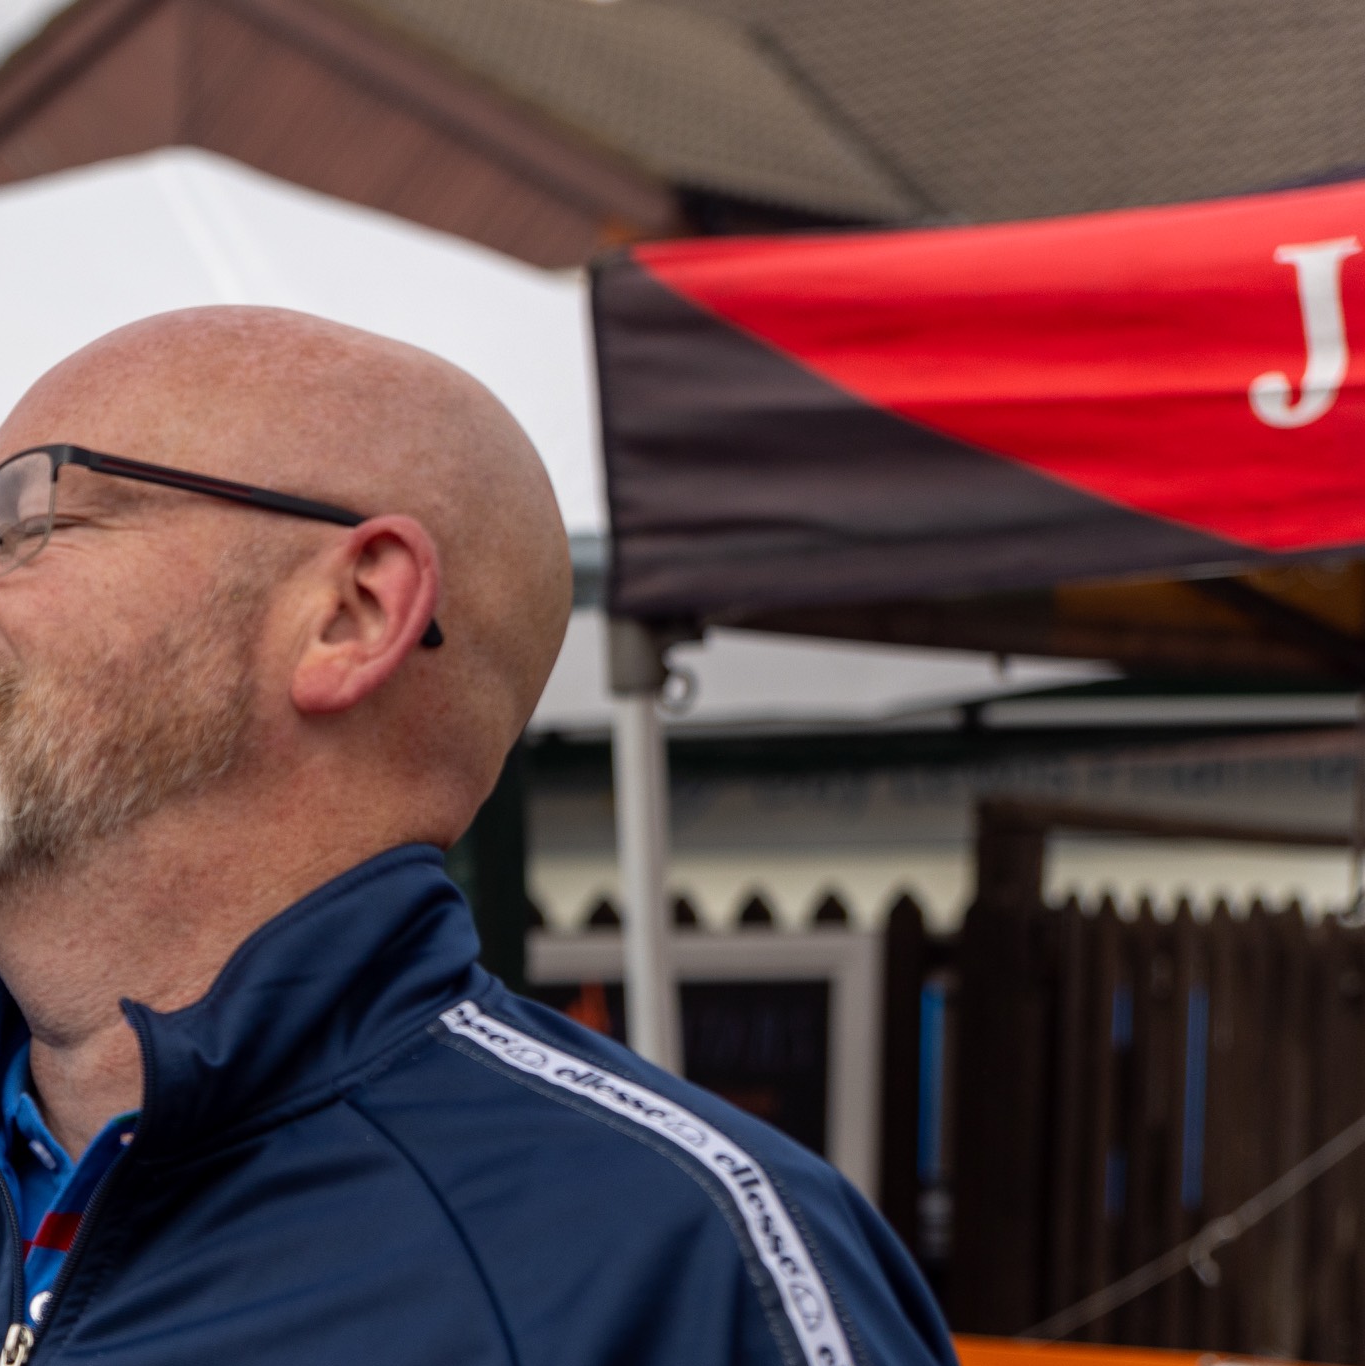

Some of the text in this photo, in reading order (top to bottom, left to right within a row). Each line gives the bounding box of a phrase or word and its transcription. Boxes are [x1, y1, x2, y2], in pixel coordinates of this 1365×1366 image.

[1247, 235, 1363, 430] J
[555, 1066, 666, 1121] ellesse
[715, 1149, 801, 1278] ellesse
